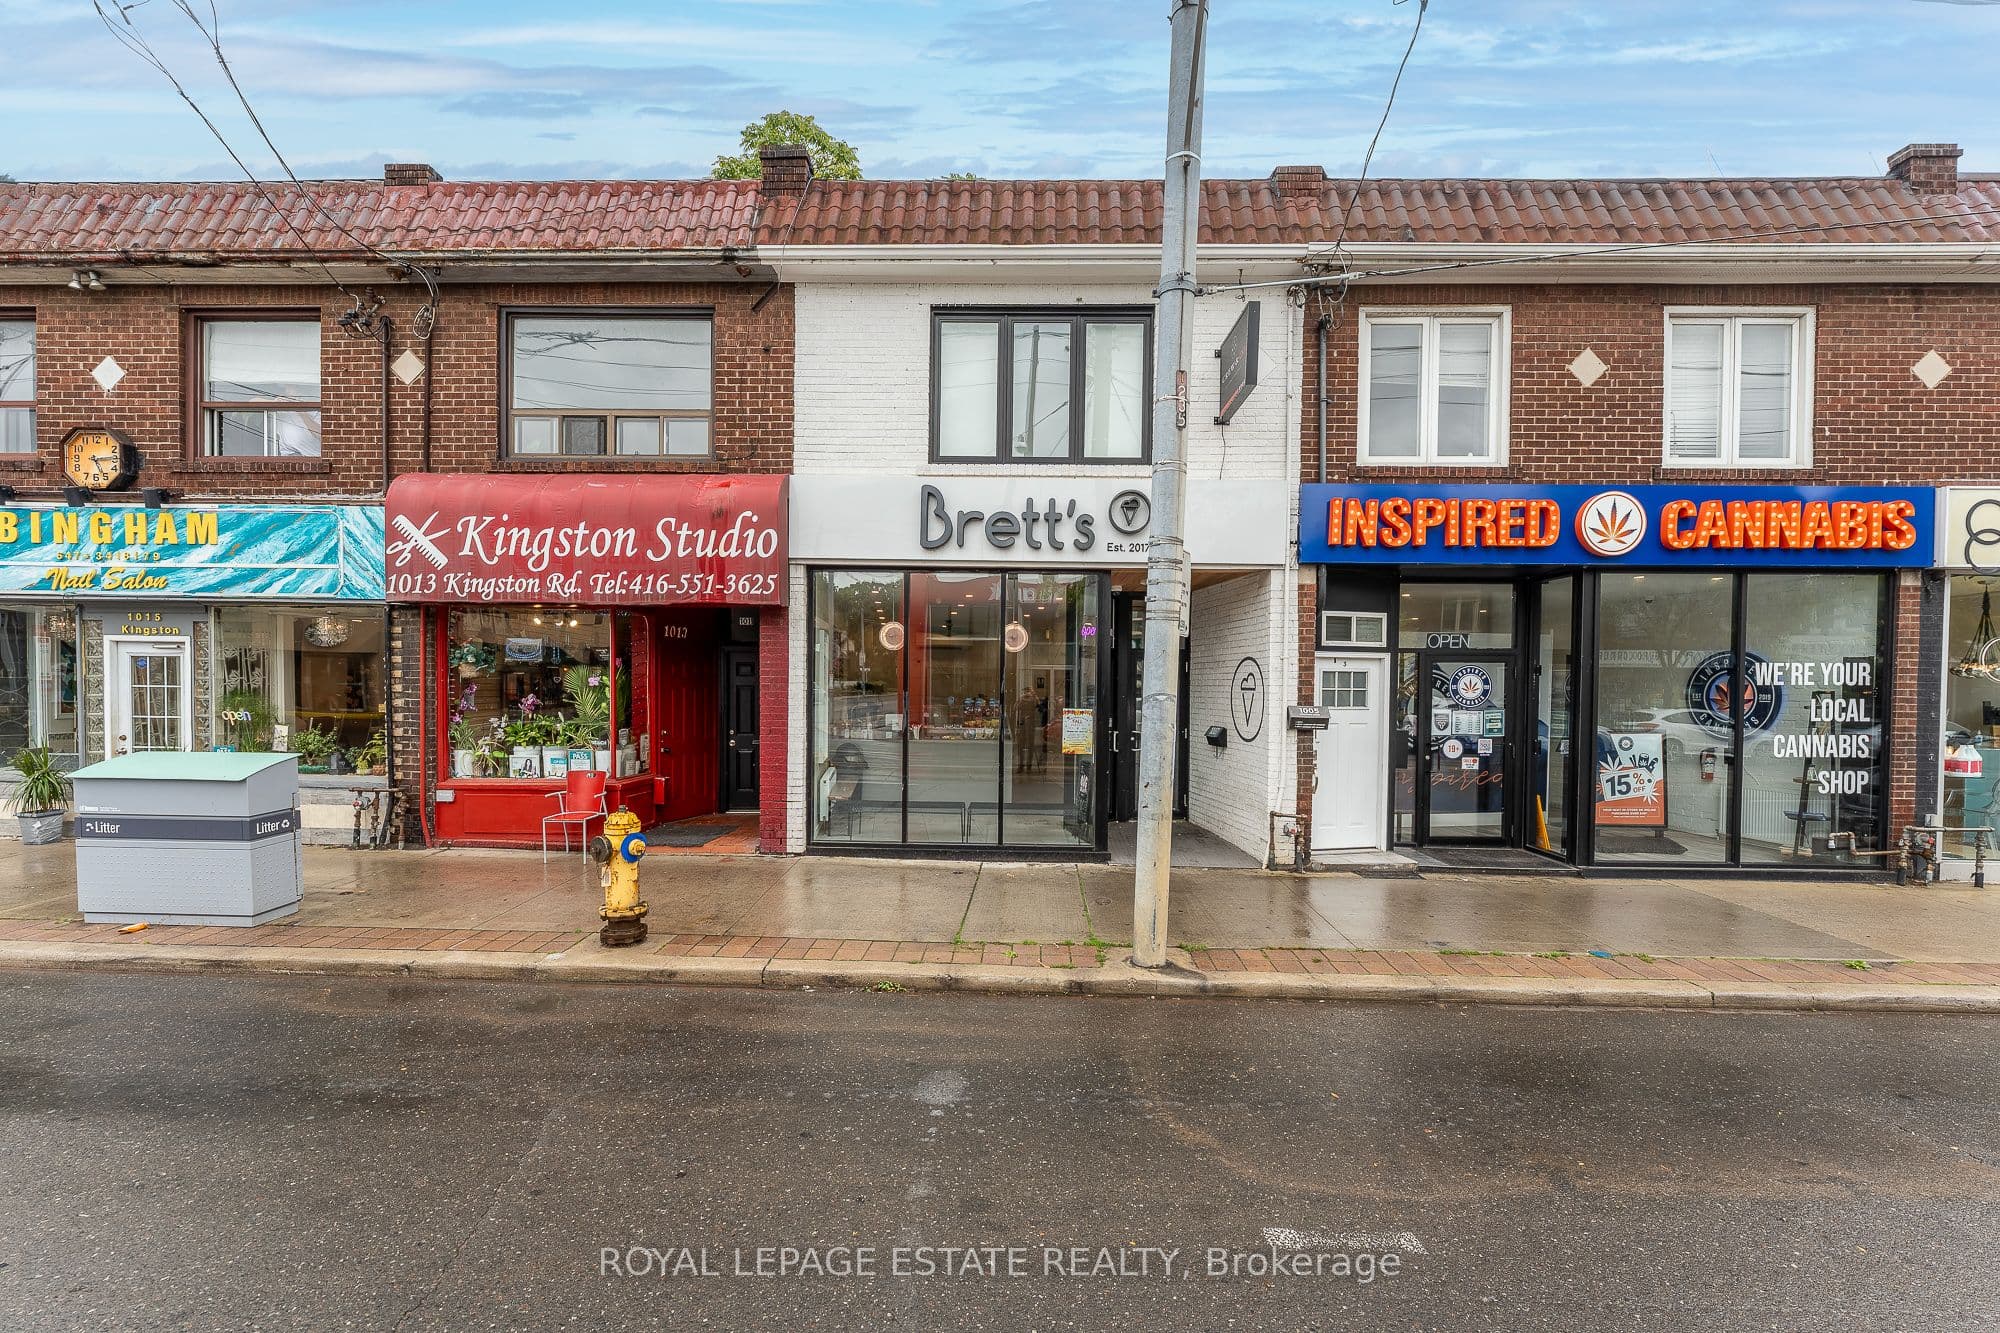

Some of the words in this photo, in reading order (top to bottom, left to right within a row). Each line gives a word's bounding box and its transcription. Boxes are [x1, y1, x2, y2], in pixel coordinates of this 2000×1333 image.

[82, 436, 89, 445] 11
[92, 435, 101, 444] 12
[74, 445, 83, 453] 10
[111, 446, 118, 454] 2
[74, 455, 80, 463] 9
[111, 455, 118, 463] 3
[74, 464, 81, 472] 8
[111, 465, 118, 473] 4
[83, 473, 89, 481] 7
[93, 473, 100, 481] 6
[102, 473, 109, 481] 5
[920, 484, 1095, 551] Brett's
[1328, 497, 1561, 547] INSPIRED
[1660, 499, 1917, 550] CANNABIS
[0, 511, 218, 545] BINGHAM
[457, 514, 637, 572] Kingston
[646, 511, 778, 562] Studio
[1107, 542, 1126, 552] Est.
[45, 566, 97, 590] Nail
[103, 566, 167, 590] Salon
[387, 574, 437, 594] 1013
[443, 572, 541, 601] Kingston
[547, 570, 582, 597] Rd.
[127, 612, 161, 622] 1015
[121, 625, 180, 635] Kingston
[1428, 633, 1471, 648] OPEN
[1755, 662, 1815, 686] WE'RE
[1820, 662, 1872, 686] YOUR
[1810, 698, 1871, 722] LOCAL
[221, 710, 252, 726] open
[1773, 734, 1870, 758] CANNABIS
[1605, 774, 1632, 797] 15
[1633, 772, 1645, 785] %
[1817, 770, 1869, 794] SHOP
[95, 821, 121, 834] Litter
[256, 821, 281, 835] Litter
